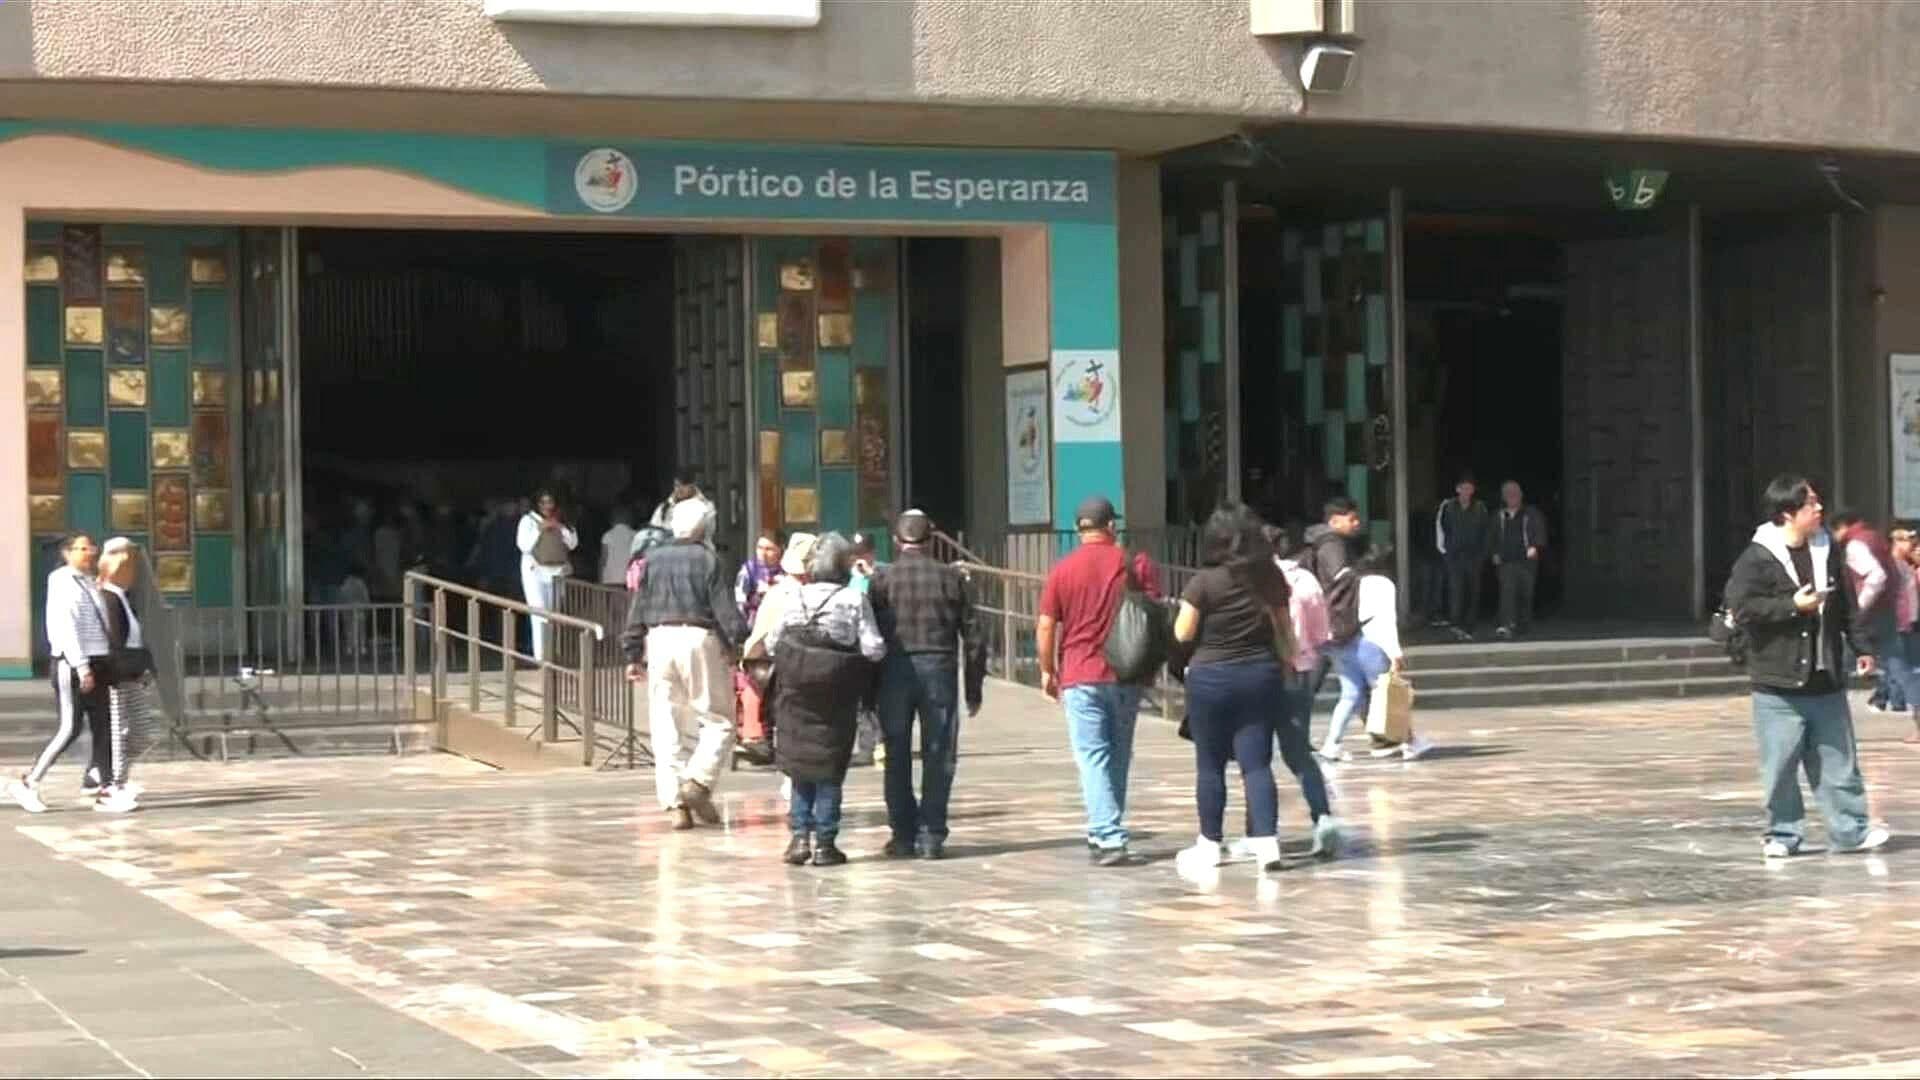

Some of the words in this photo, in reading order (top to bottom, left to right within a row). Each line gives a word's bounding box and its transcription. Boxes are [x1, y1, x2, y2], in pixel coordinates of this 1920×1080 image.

[675, 165, 803, 198] Pórtico
[815, 169, 856, 199] de
[869, 171, 897, 200] la
[910, 171, 1089, 207] Esperanza
